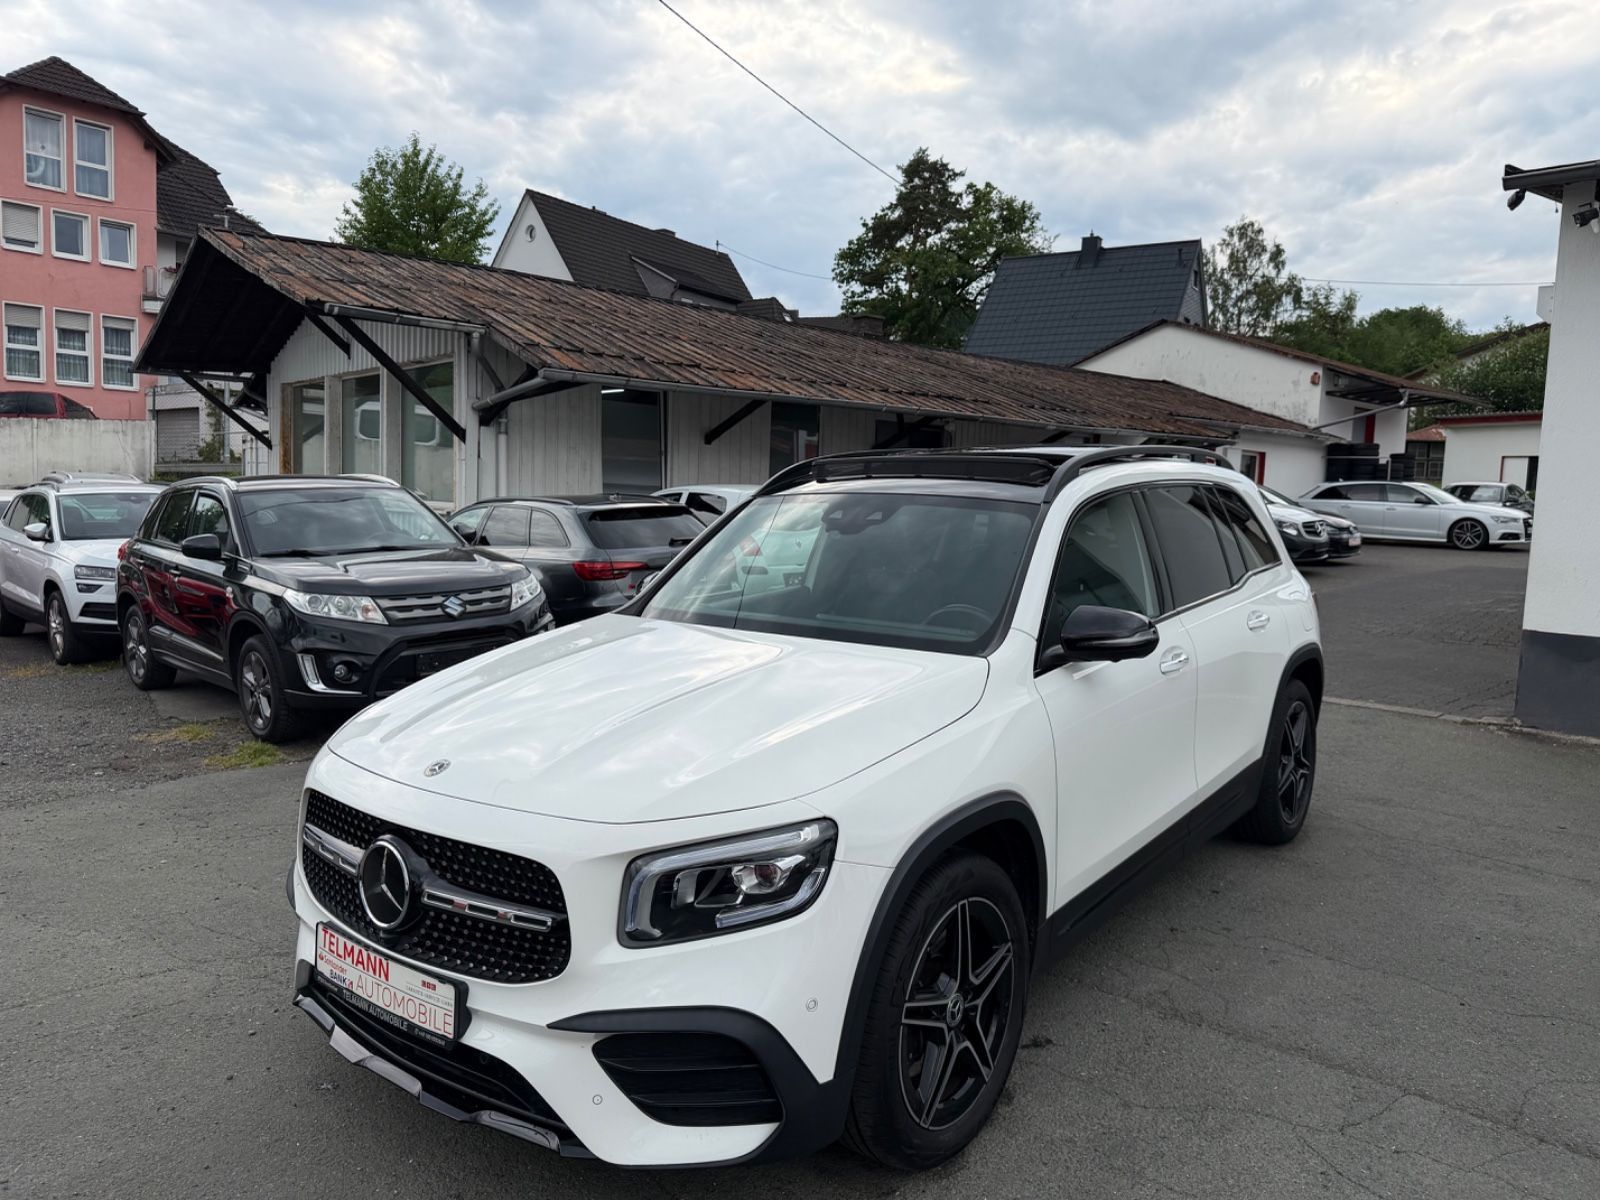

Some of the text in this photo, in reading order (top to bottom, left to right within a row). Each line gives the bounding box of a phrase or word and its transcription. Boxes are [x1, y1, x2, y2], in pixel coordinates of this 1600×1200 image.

[321, 928, 390, 982] TELMANN
[343, 989, 408, 1032] TELMANN AUTOMOBILE
[356, 974, 453, 1036] AUTOMOBILE
